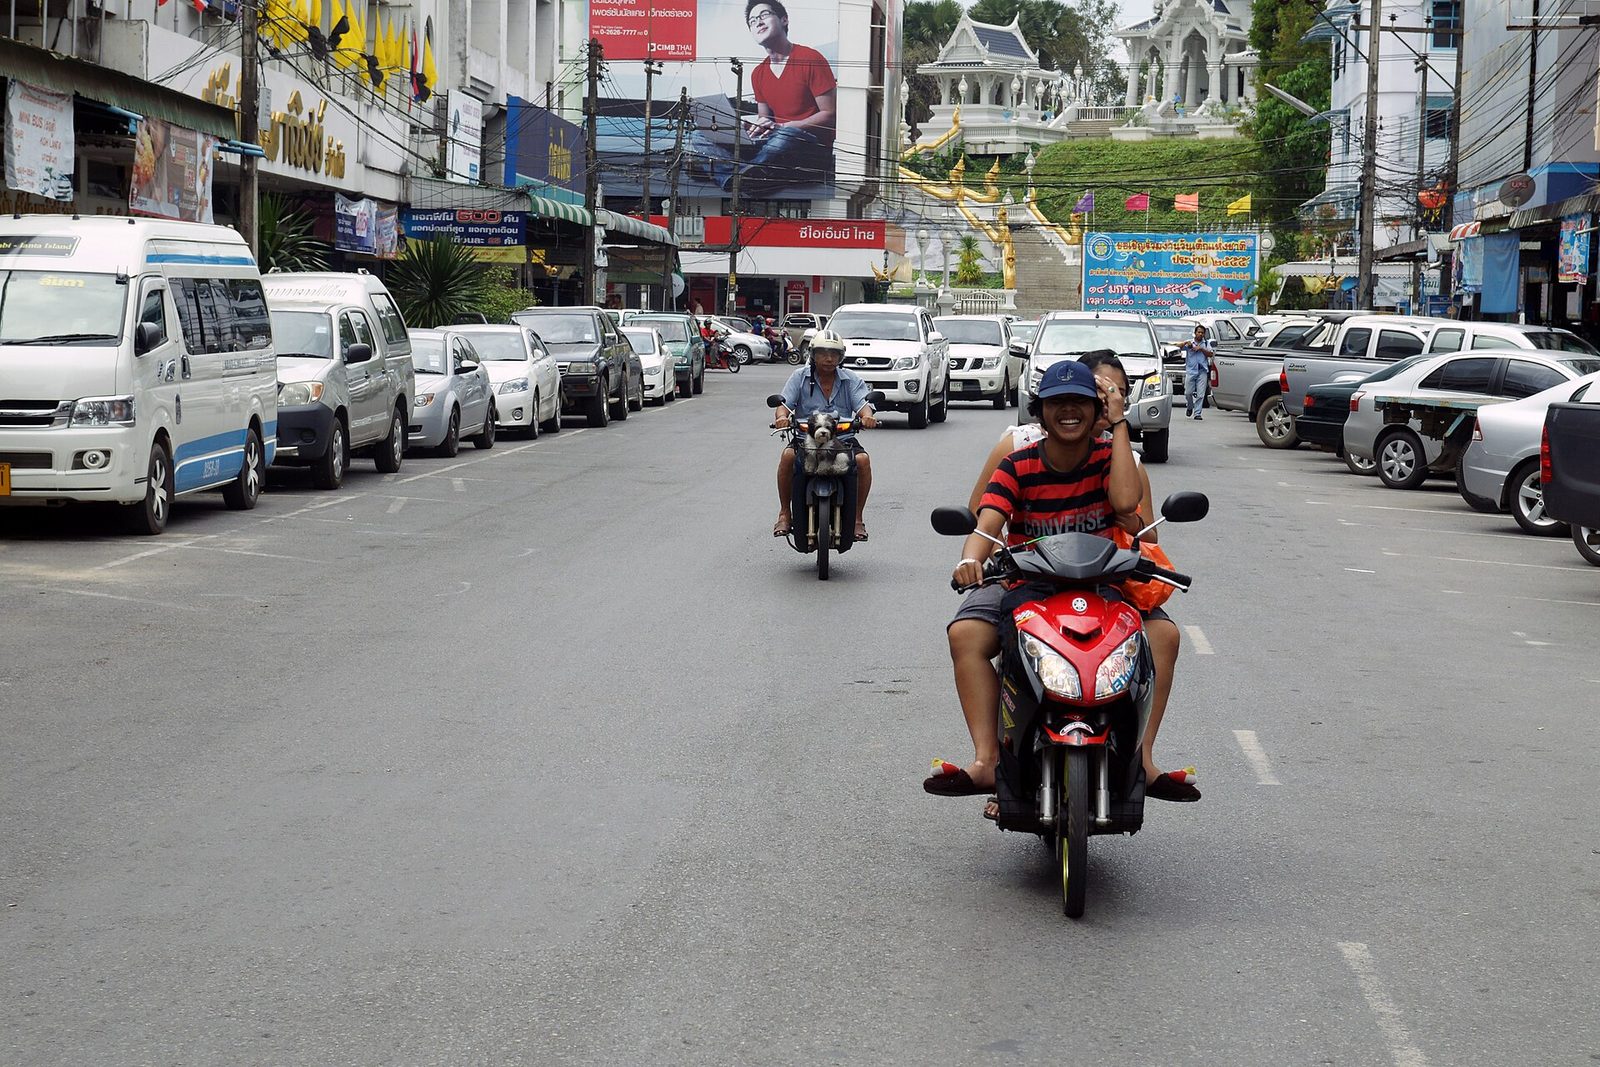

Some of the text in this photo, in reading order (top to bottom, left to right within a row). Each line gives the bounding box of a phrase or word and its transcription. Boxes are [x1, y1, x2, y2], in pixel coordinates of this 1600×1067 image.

[32, 114, 43, 128] BUS
[504, 214, 519, 223] คัน
[799, 226, 875, 240] ซีไอเอ็มบี ไทย
[1172, 254, 1250, 267] ประจำปี ๒๕๕๕
[1108, 284, 1150, 294] มกราคม
[1153, 284, 1191, 294] ๒๕๕๕
[1024, 508, 1106, 537] CONVERSE
